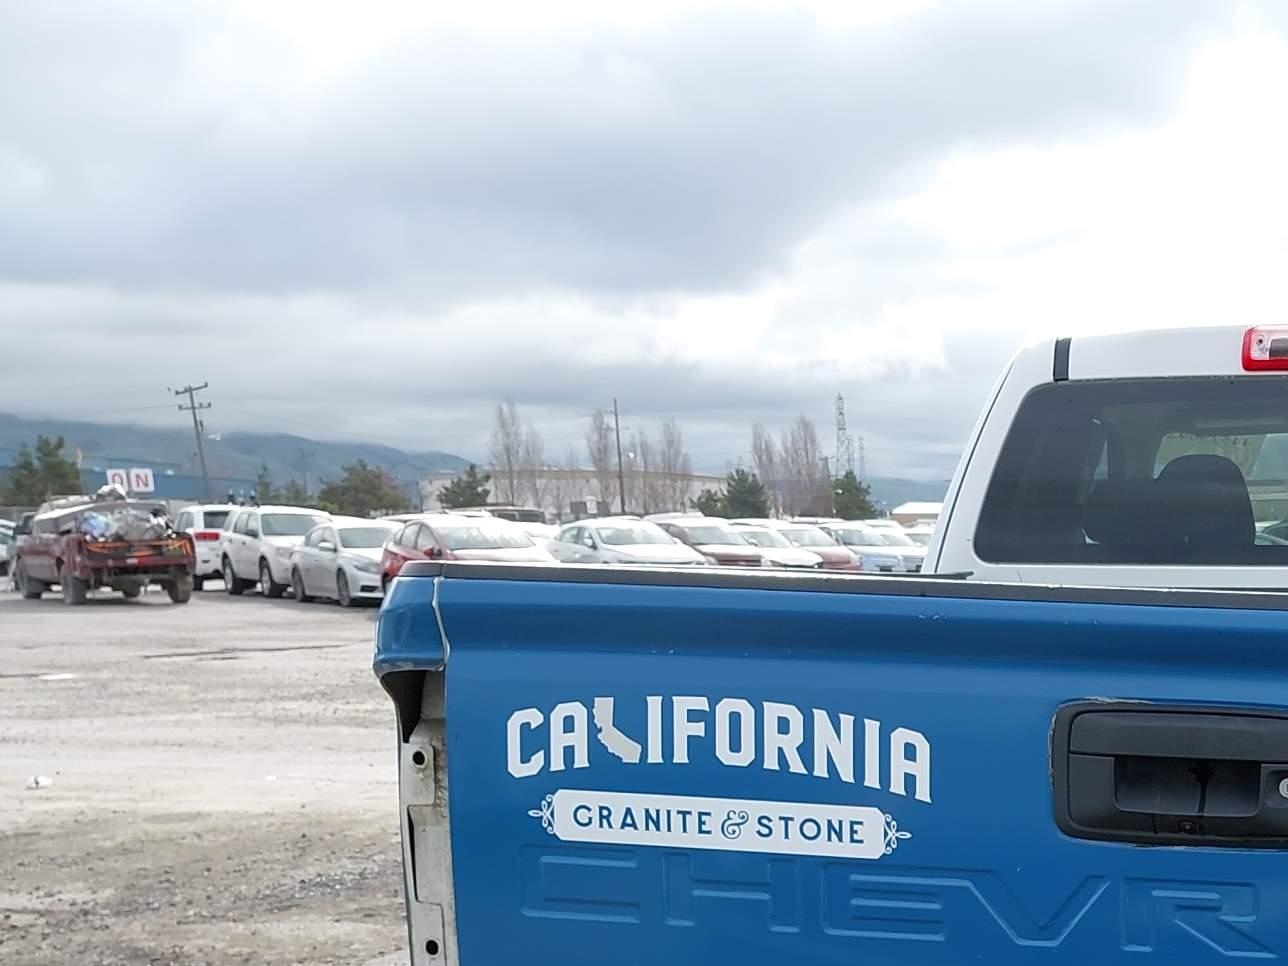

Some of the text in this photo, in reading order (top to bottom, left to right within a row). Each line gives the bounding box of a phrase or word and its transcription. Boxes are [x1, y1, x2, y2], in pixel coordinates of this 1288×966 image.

[506, 695, 933, 804] CALIFORNIA
[572, 804, 865, 844] GRANITE & STONE
